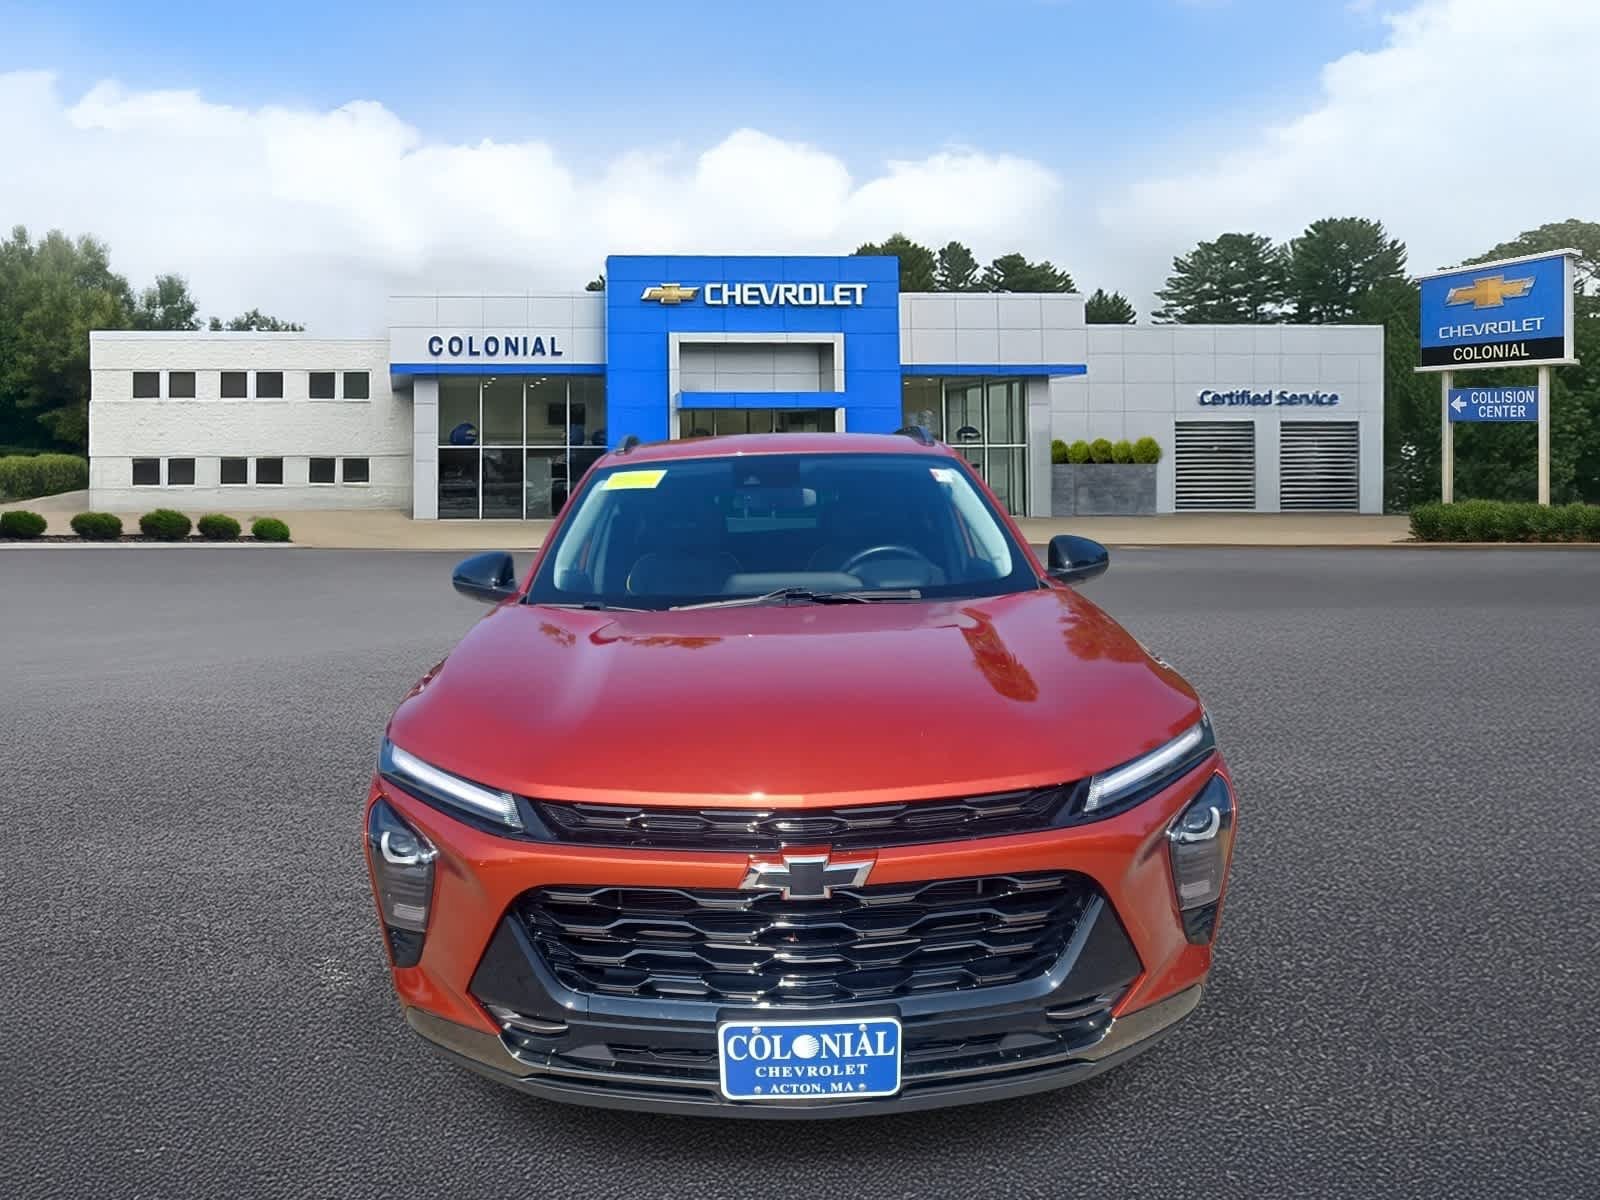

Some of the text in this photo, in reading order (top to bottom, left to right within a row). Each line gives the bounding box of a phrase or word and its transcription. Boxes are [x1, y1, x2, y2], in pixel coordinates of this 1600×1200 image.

[704, 283, 868, 307] CHEVROLET
[1439, 317, 1545, 339] CHEVROLET
[428, 335, 563, 357] COLONIAL
[1453, 342, 1530, 361] COLONIAL
[1199, 390, 1339, 406] Certified Service
[1471, 390, 1535, 404] COLLISION
[1478, 405, 1526, 418] CENTER
[727, 1031, 895, 1061] COLONIAL
[755, 1063, 868, 1078] CHEVROLET
[770, 1082, 854, 1094] ACTON, MA
